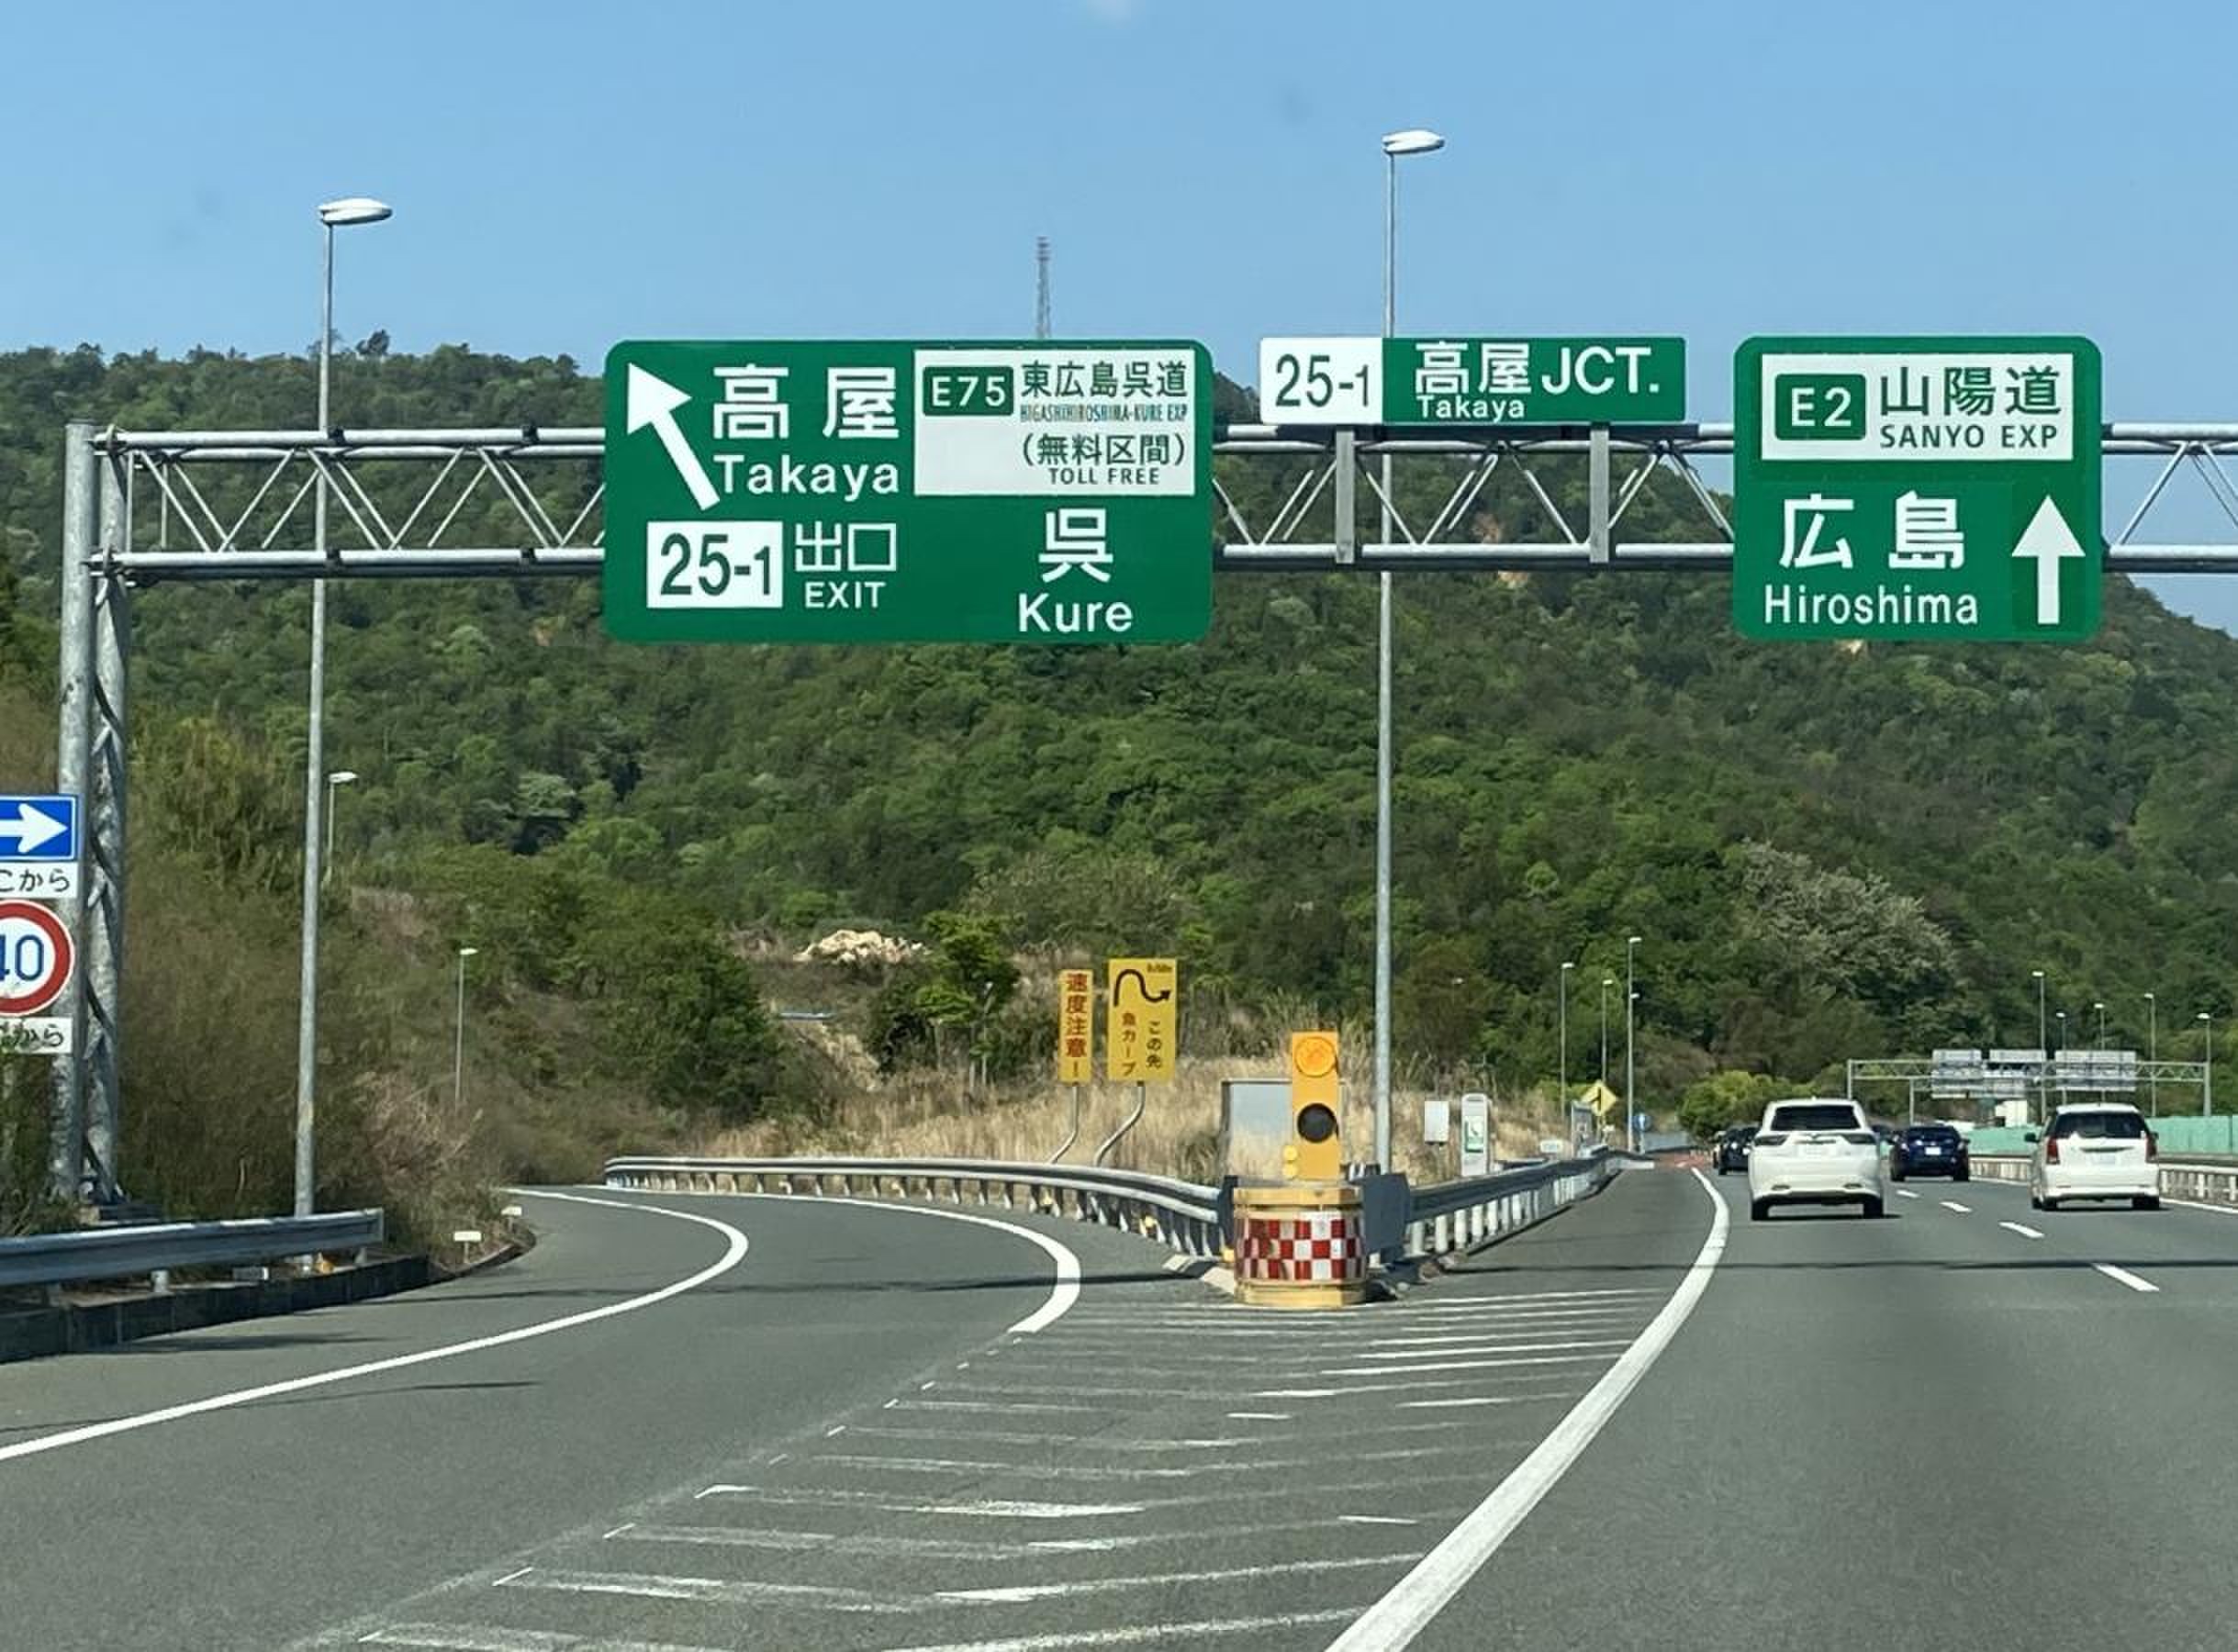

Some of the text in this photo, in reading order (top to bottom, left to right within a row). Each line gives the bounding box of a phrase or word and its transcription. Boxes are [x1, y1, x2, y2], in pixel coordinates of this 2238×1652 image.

[1021, 359, 1188, 398] 東広島呉道
[1275, 353, 1369, 407] 25-1
[1415, 340, 1660, 395] 高屋 JCT.
[713, 363, 900, 440] 高屋
[931, 375, 1007, 407] E75
[1416, 396, 1525, 423] Takaya
[1791, 386, 1852, 428] E2
[1879, 365, 2062, 417] 山陽道
[1879, 424, 2057, 449] SANYO EXP
[714, 454, 900, 502] Takaya
[1048, 466, 1160, 486] TOLL FREE
[795, 520, 897, 572] 出口
[1038, 508, 1113, 583] 呉
[1778, 490, 1965, 570] 広島
[660, 532, 772, 597] 25-1
[804, 581, 887, 609] EXIT
[1018, 593, 1134, 633] Kure
[1764, 584, 1979, 625] Hiroshima
